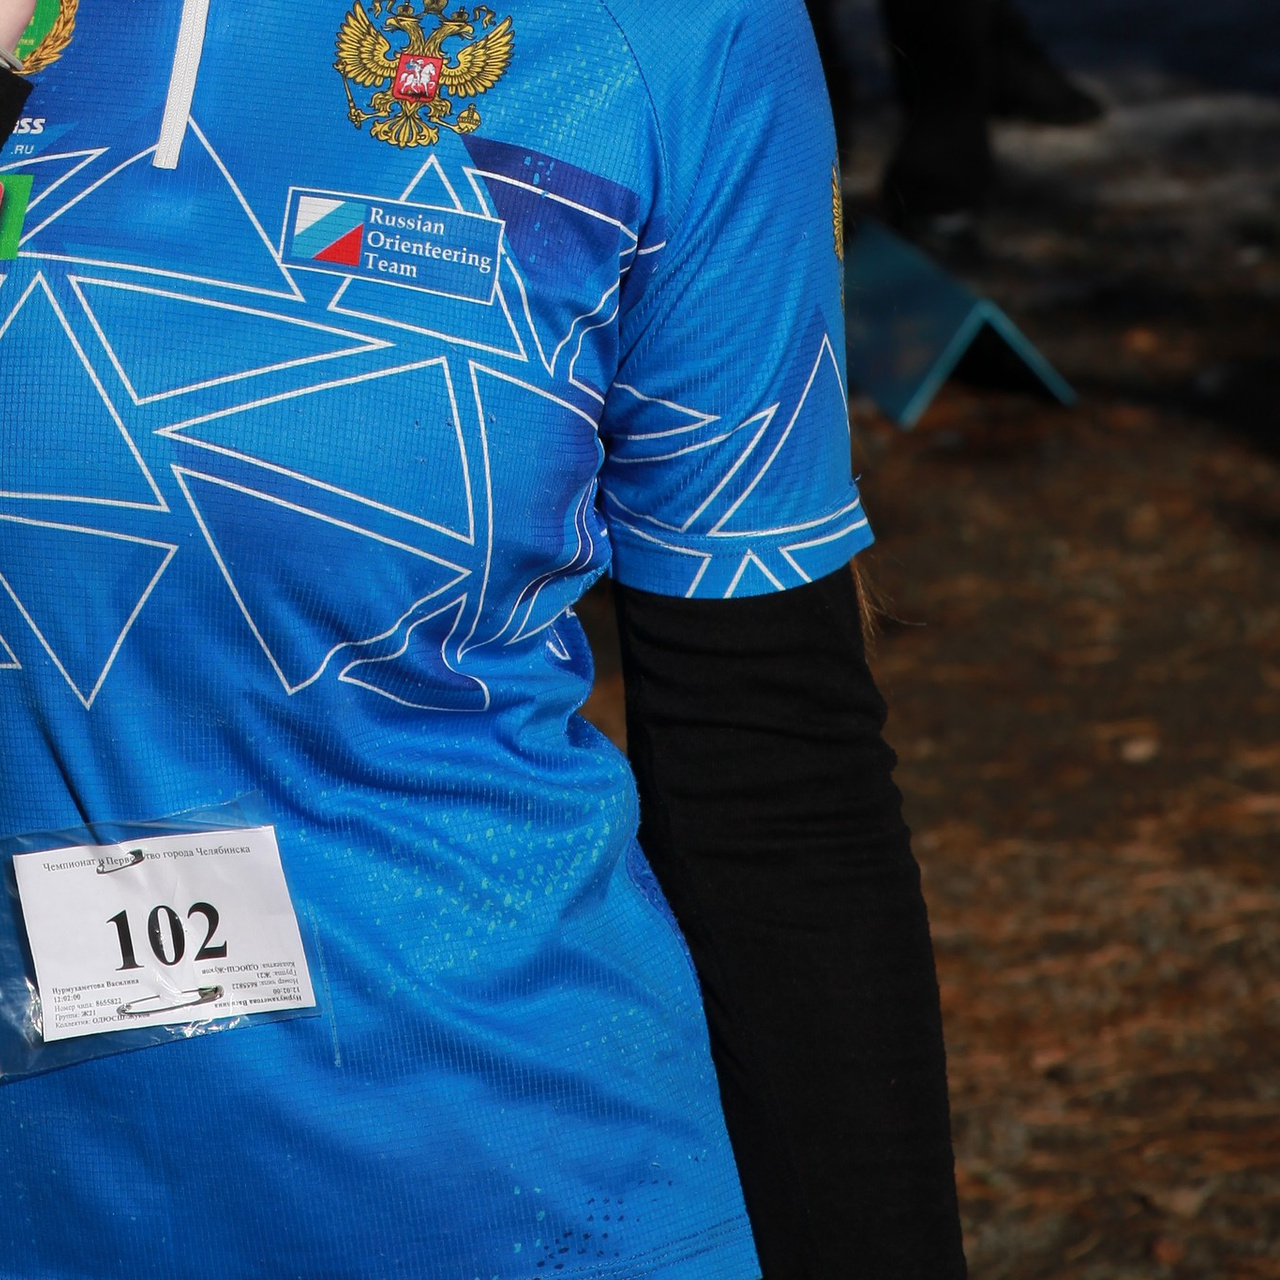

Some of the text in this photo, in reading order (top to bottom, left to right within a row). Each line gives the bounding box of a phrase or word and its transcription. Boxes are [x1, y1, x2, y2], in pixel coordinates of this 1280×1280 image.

[370, 206, 445, 235] Russian
[367, 231, 492, 273] Orienteering
[364, 253, 418, 279] Team
[42, 858, 97, 872] Чемпионат
[162, 849, 194, 860] города
[196, 845, 251, 857] Челябинска
[105, 901, 228, 972] 102
[53, 993, 81, 1003] 12:02:00
[54, 1004, 75, 1012] Номер
[95, 997, 122, 1008] 8655822
[81, 1009, 96, 1017] Ж21
